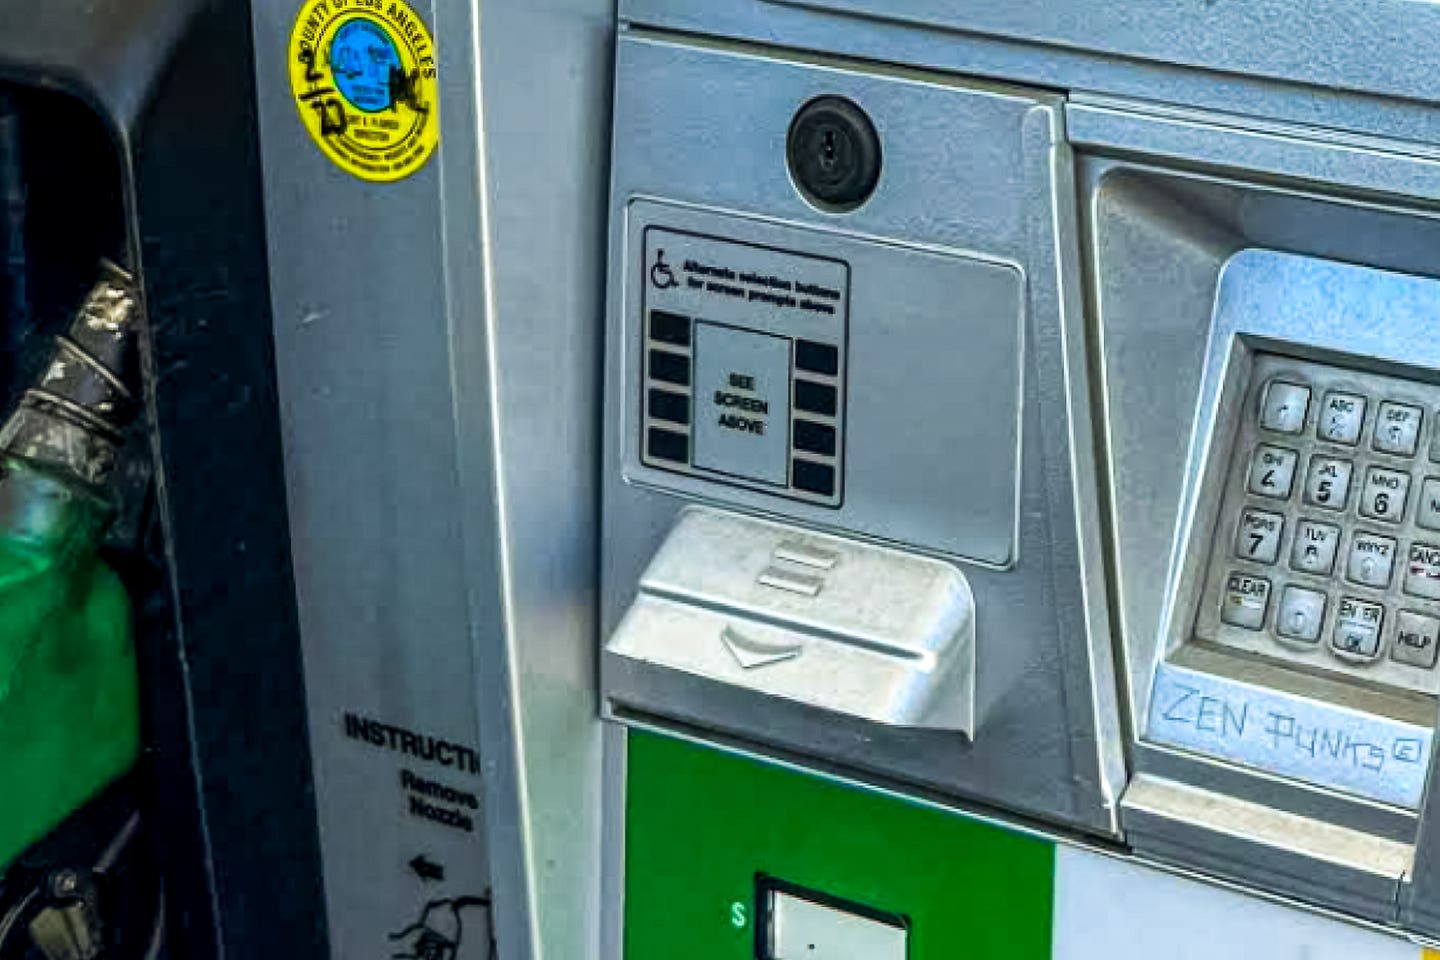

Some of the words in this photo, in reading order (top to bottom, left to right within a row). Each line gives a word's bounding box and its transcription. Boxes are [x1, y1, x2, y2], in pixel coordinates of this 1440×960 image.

[1316, 481, 1333, 503] 5
[1374, 493, 1390, 514] 6
[1249, 533, 1265, 555] 7
[1161, 681, 1249, 737] ZEN
[400, 768, 479, 810] Remove
[408, 797, 474, 833] Nozzle
[731, 901, 748, 928] $
